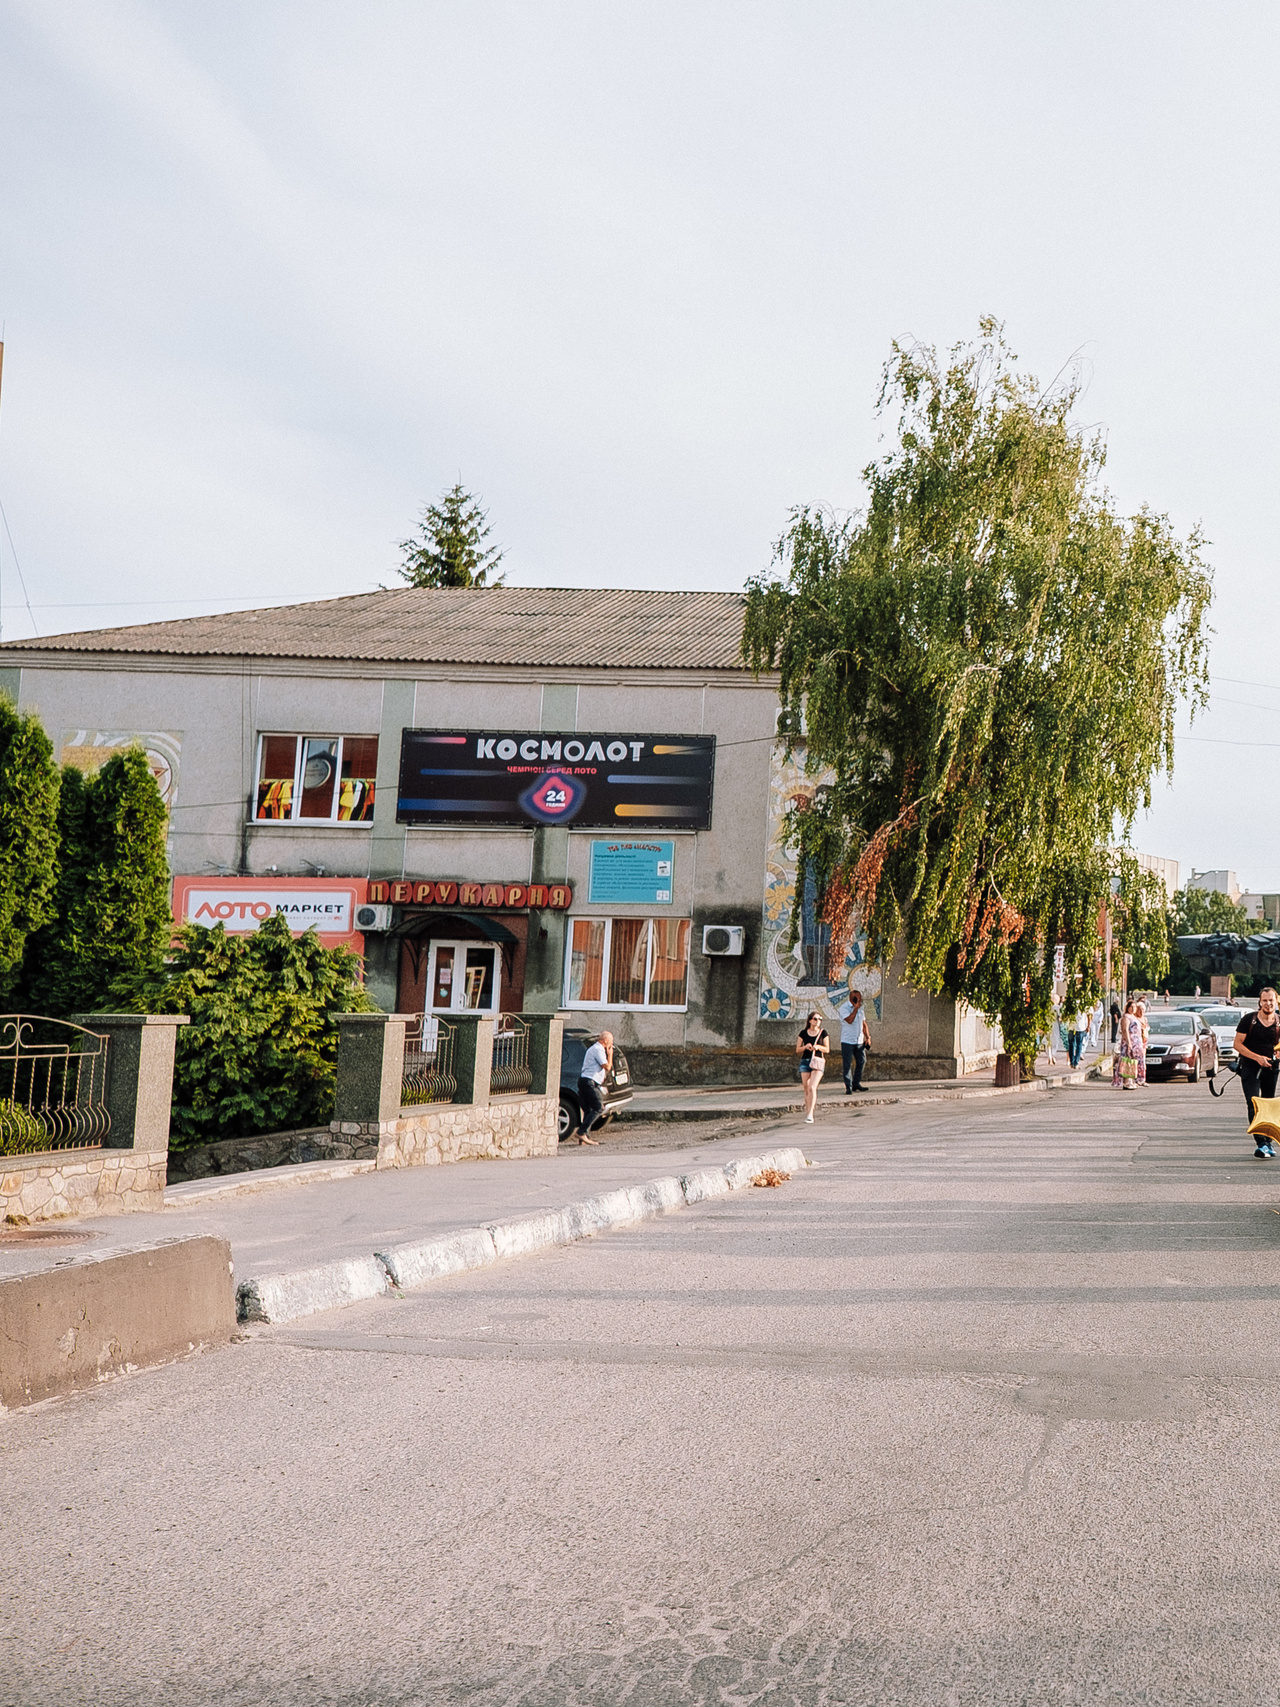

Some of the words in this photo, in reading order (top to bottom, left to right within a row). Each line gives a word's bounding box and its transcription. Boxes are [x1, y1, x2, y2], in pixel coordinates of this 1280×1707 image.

[477, 738, 645, 762] КОСМОЛОТ
[574, 767, 597, 775] ЛОТО
[546, 790, 566, 802] 24
[370, 883, 566, 906] ПЕРУКАРНЯ
[194, 901, 271, 920] ЛОТО
[276, 904, 344, 914] МАРКЕТ
